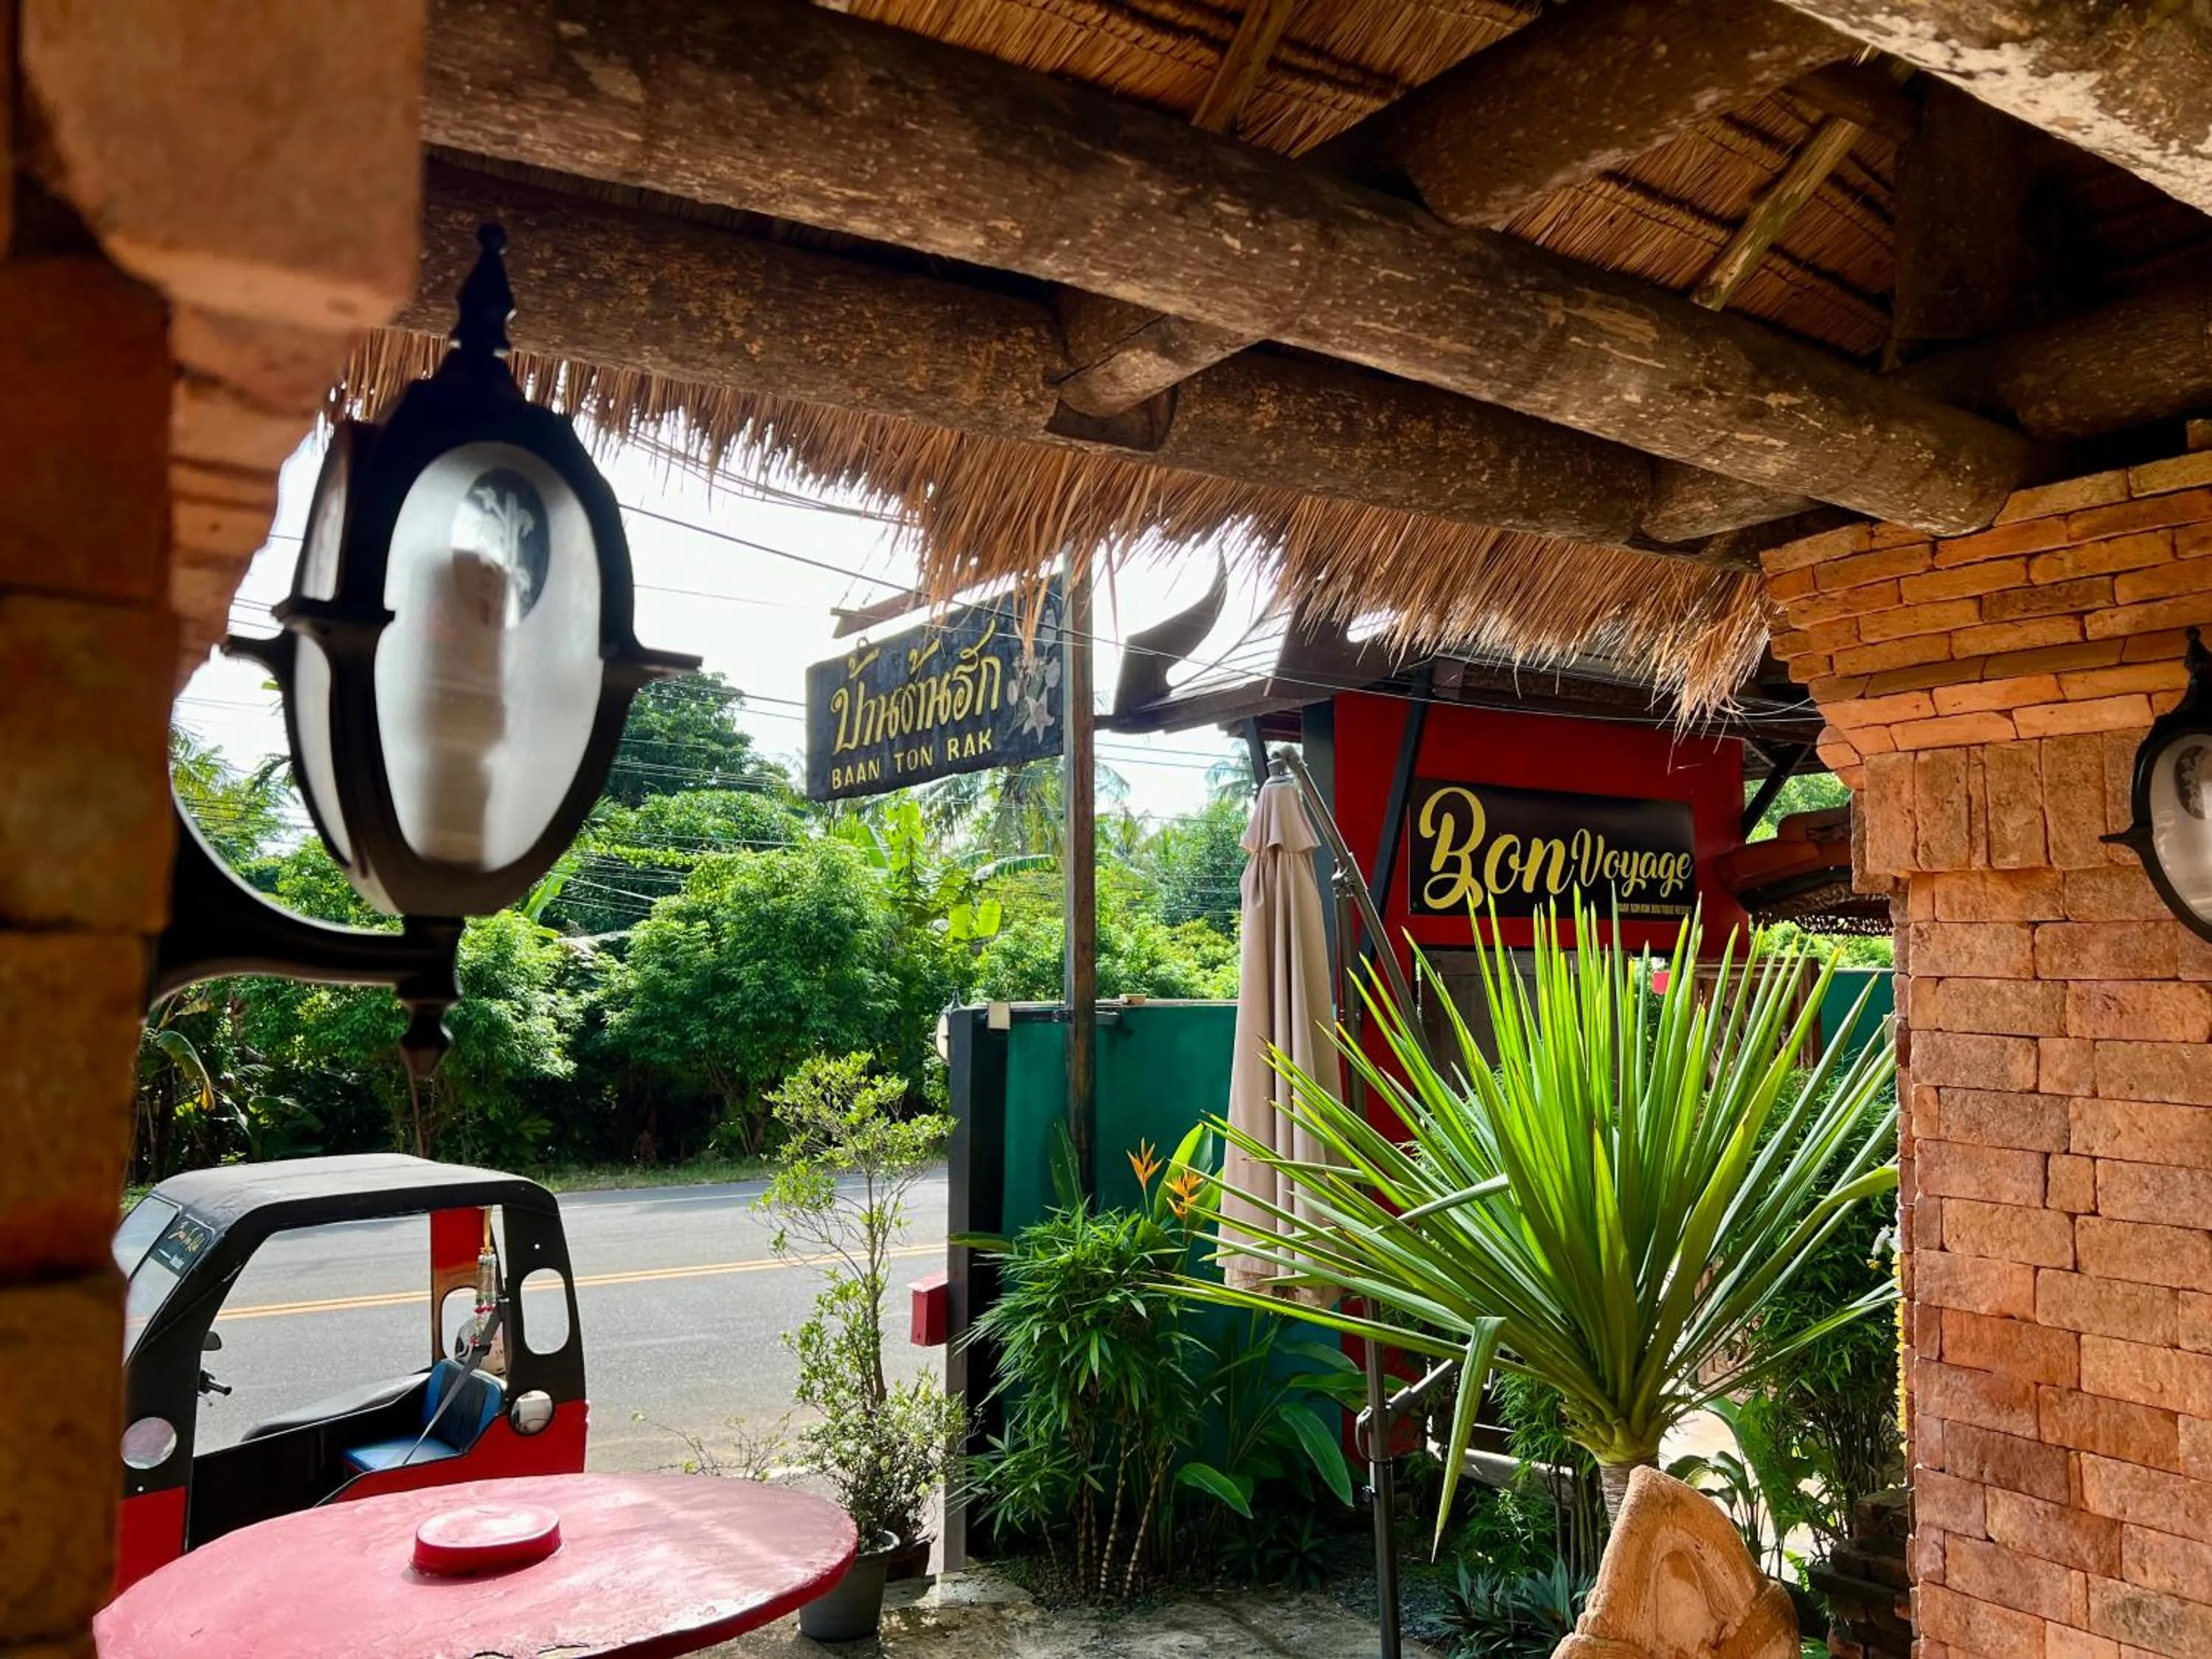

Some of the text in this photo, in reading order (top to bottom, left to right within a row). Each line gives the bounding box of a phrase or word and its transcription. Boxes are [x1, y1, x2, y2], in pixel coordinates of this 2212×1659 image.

[832, 728, 992, 790] BAAN TON RAK
[1419, 787, 1694, 910] Bon Voyage
